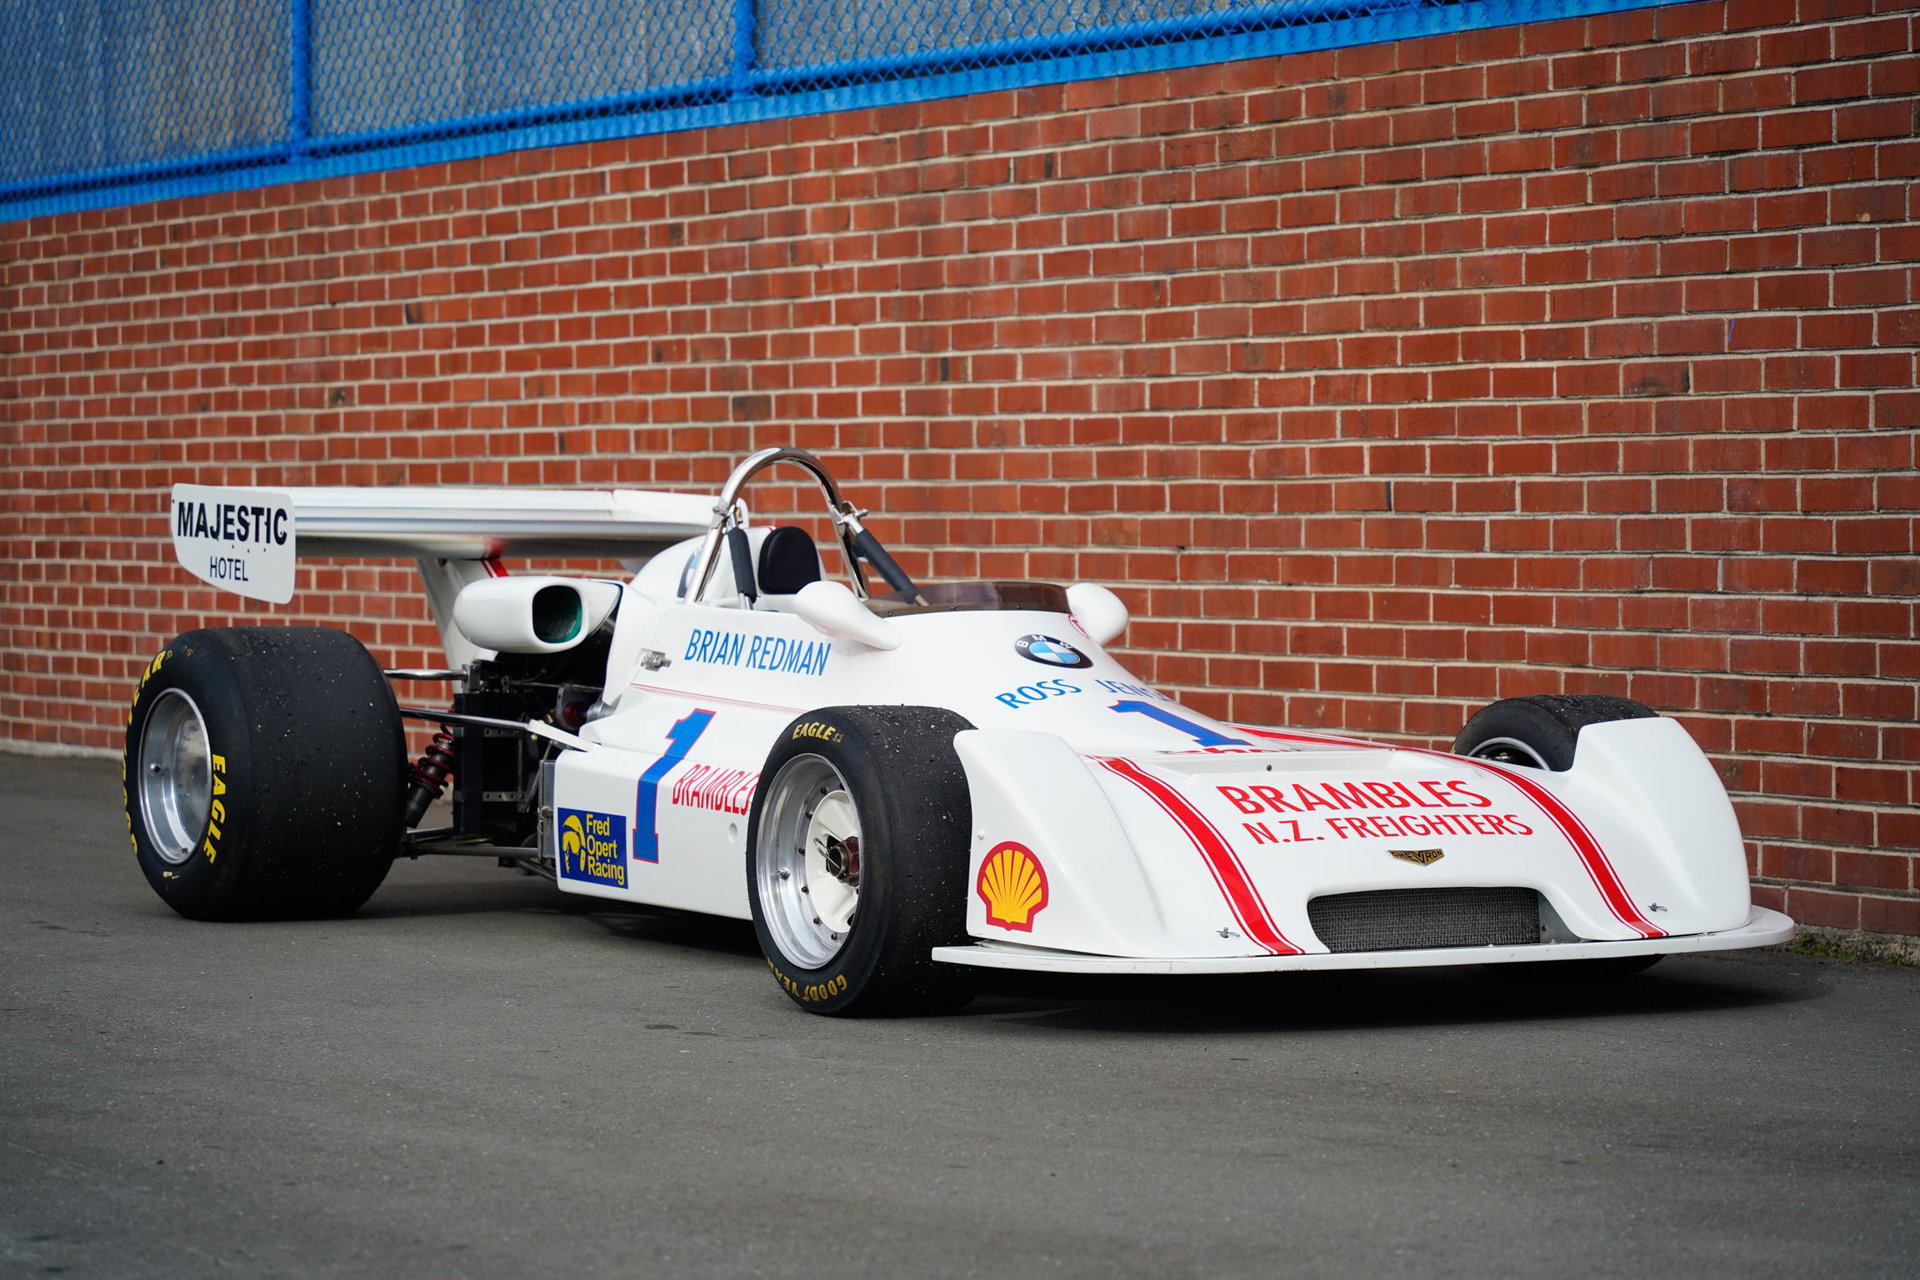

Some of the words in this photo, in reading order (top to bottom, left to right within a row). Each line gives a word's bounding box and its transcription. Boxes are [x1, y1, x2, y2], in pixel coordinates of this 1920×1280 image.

[177, 502, 288, 545] MAJESTIC
[210, 556, 249, 581] HOTEL
[684, 629, 746, 667] BRIAN
[745, 635, 832, 676] REDMAN
[994, 678, 1083, 709] ROSS
[792, 722, 836, 740] EAGLE
[633, 707, 717, 864] 1
[1216, 780, 1492, 814] BRAMBLES
[203, 754, 227, 864] EAGLE
[586, 814, 610, 836] Fred
[1242, 820, 1324, 845] N.Z.
[1327, 814, 1534, 839] FREIGHTERS
[587, 835, 618, 860] Opert
[587, 857, 625, 886] Racing
